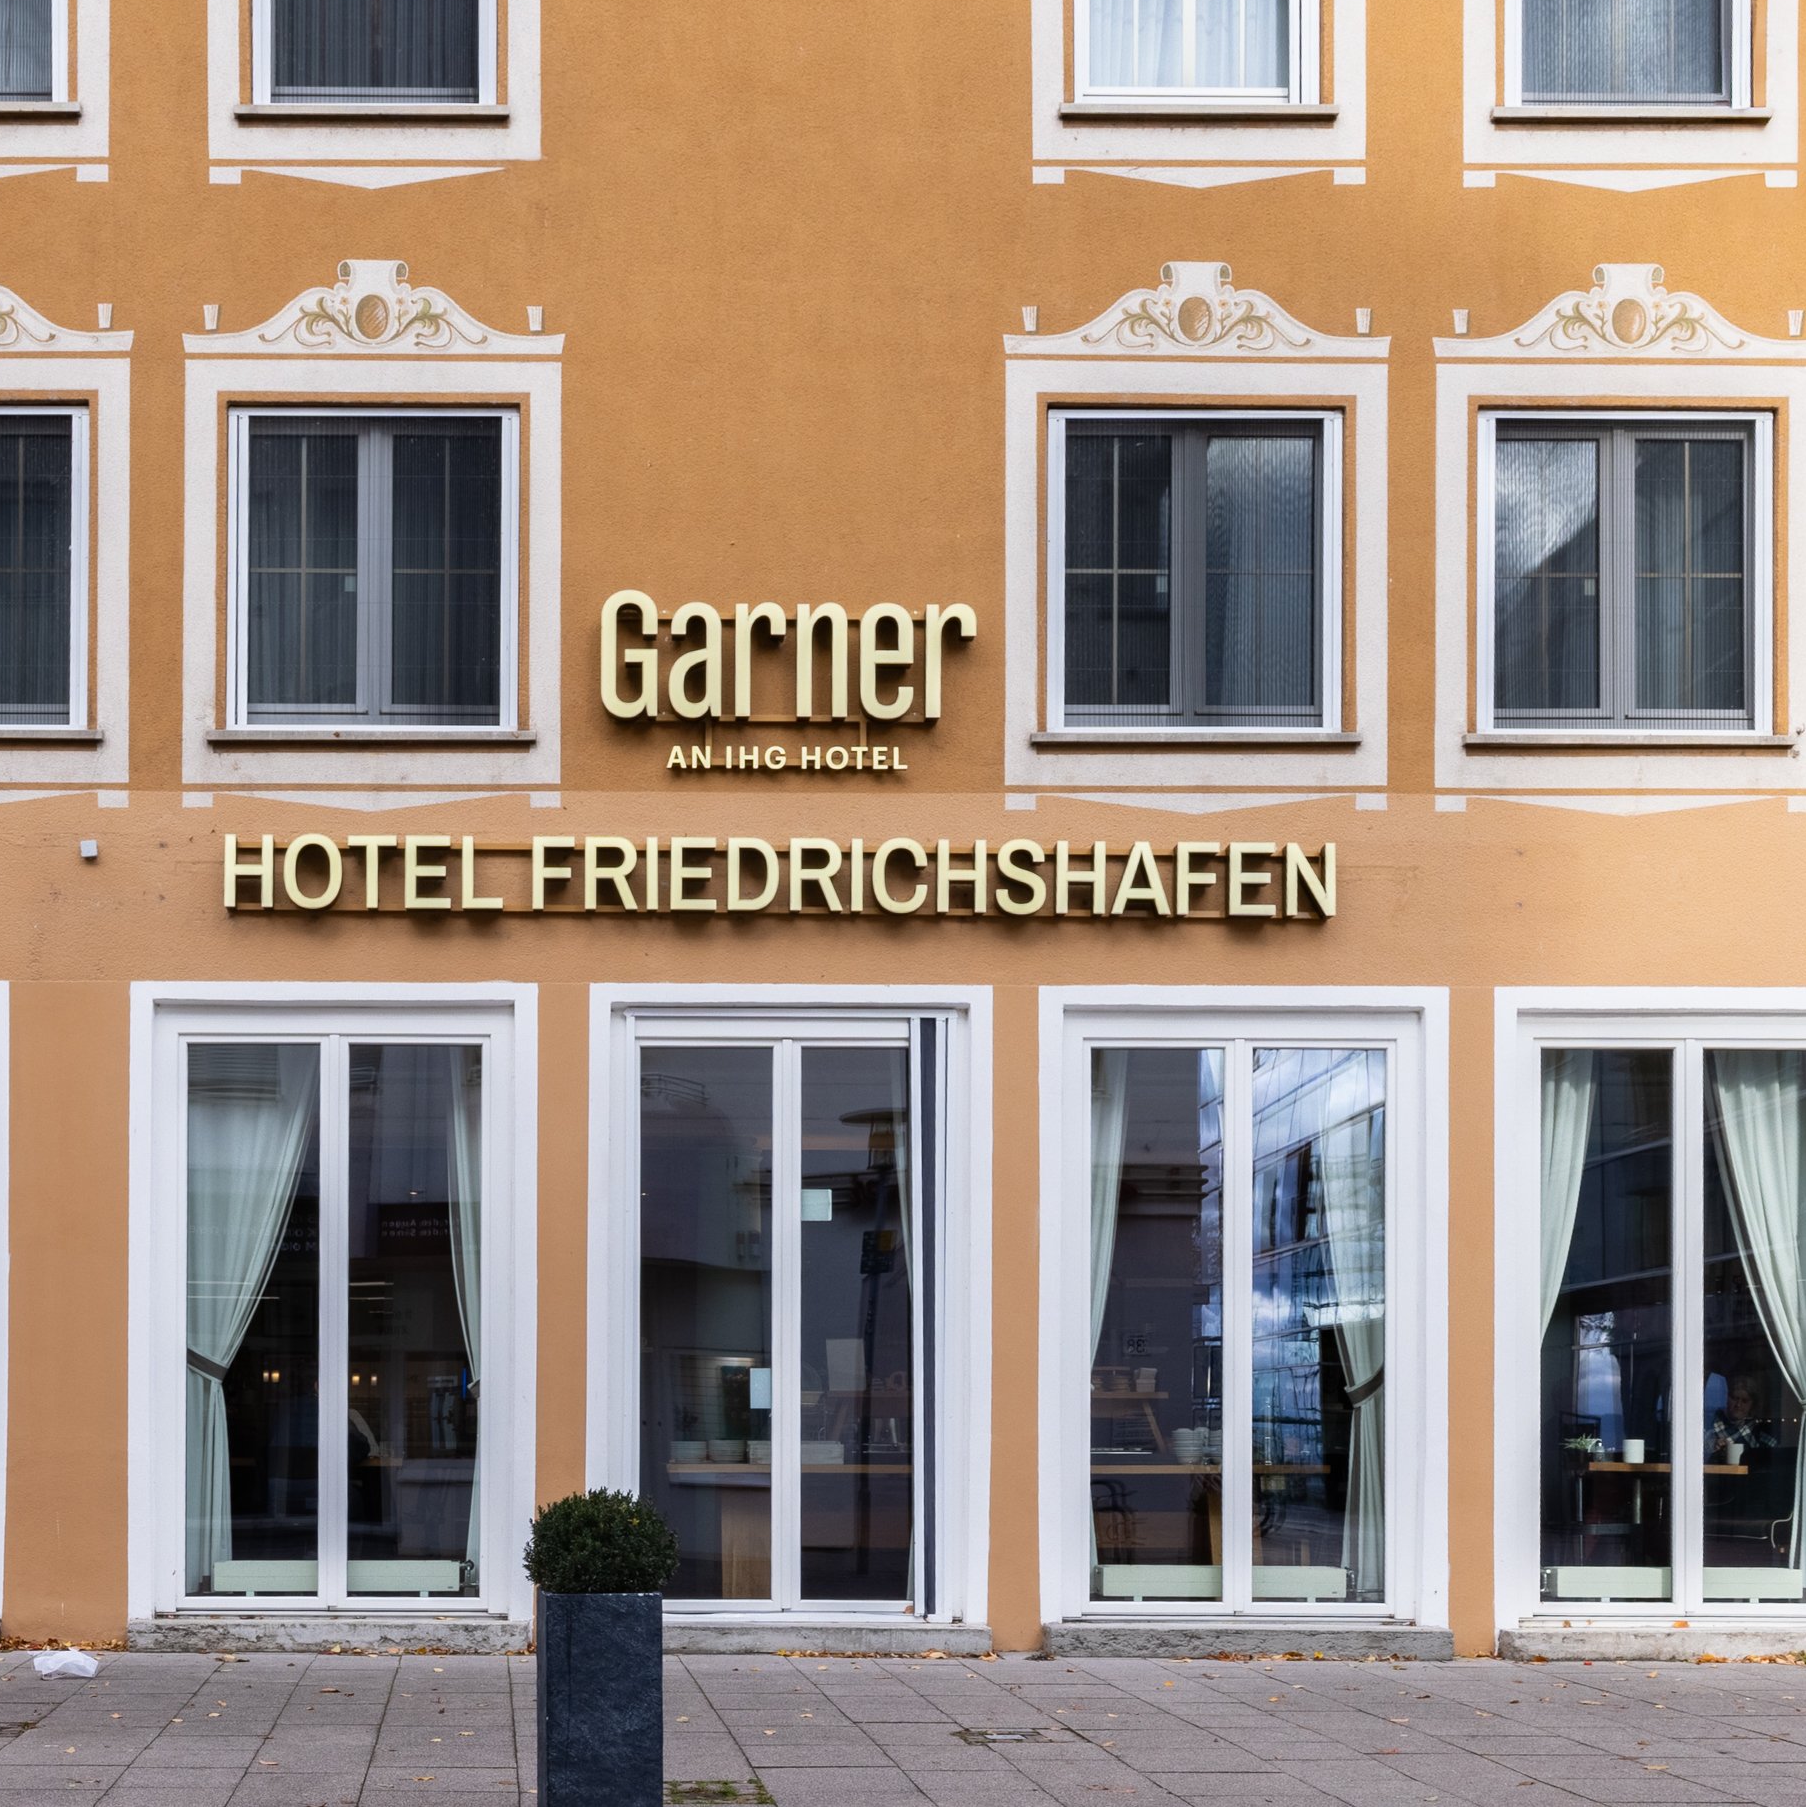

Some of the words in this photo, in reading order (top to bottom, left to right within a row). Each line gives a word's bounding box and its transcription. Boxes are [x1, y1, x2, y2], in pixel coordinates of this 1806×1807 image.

[600, 589, 977, 721] Garner
[666, 745, 712, 769] AN
[725, 745, 787, 770] IHG
[801, 746, 908, 770] HOTEL
[223, 832, 504, 909] HOTEL
[531, 835, 1337, 918] FRIEDRICHSHAFEN
